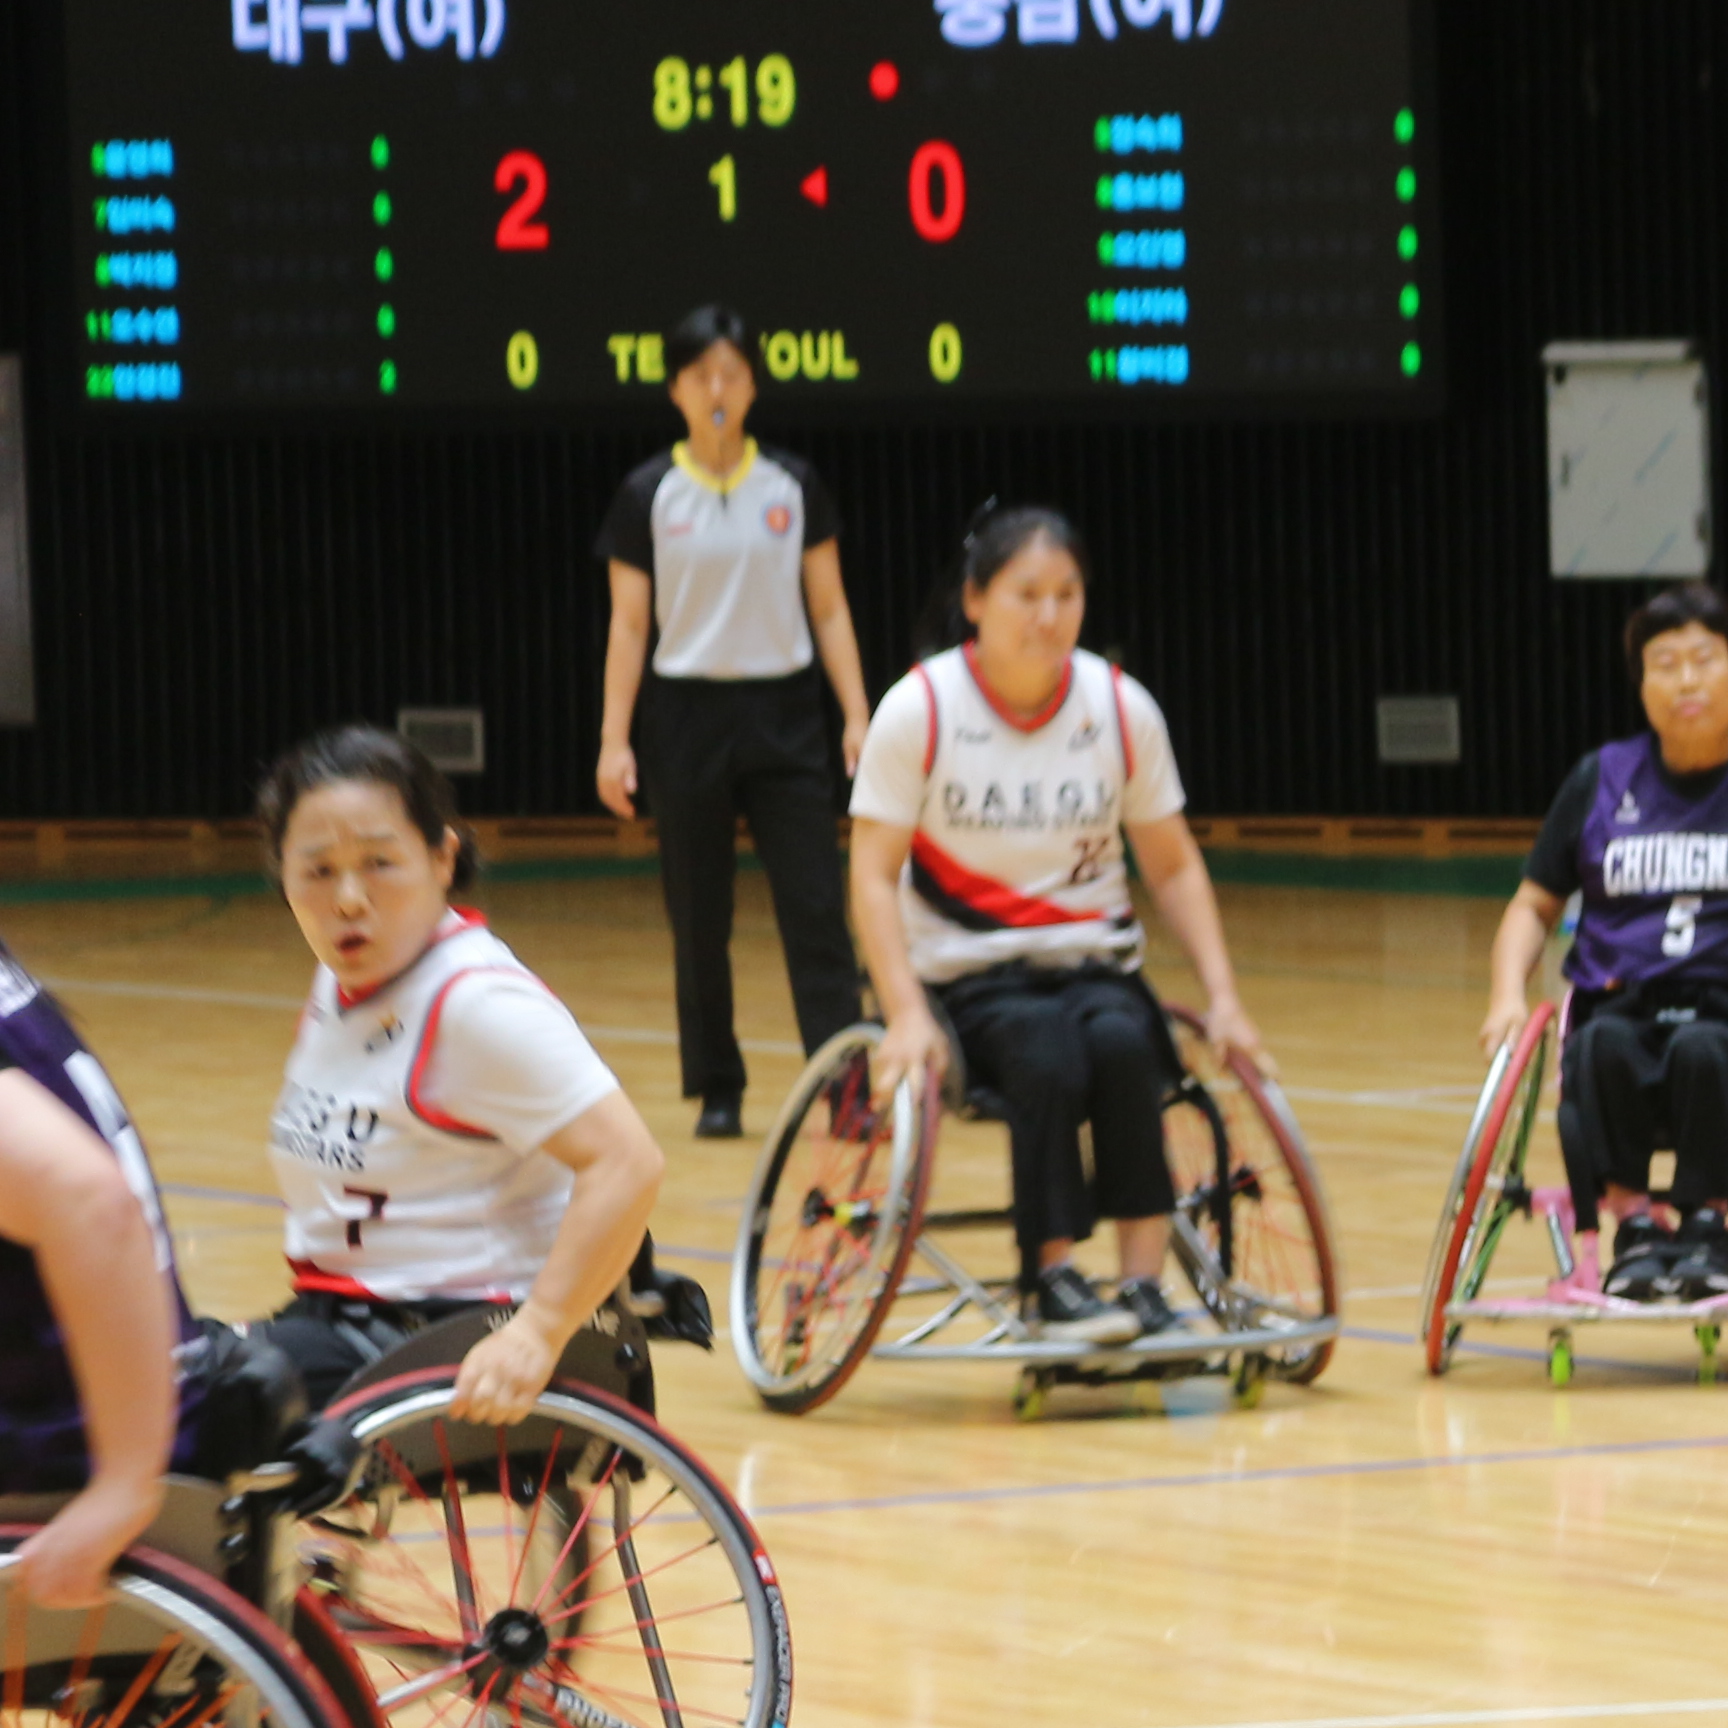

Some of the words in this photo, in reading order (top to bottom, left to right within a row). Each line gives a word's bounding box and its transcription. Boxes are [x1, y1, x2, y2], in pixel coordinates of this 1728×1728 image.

[653, 53, 797, 131] 8:19
[494, 149, 551, 250] 2
[708, 153, 737, 222] 1
[908, 138, 967, 243] 0
[506, 329, 538, 390] 0
[760, 329, 860, 382] OUL
[929, 322, 963, 383] 0
[1661, 895, 1703, 957] 5
[343, 1184, 390, 1248] 7
